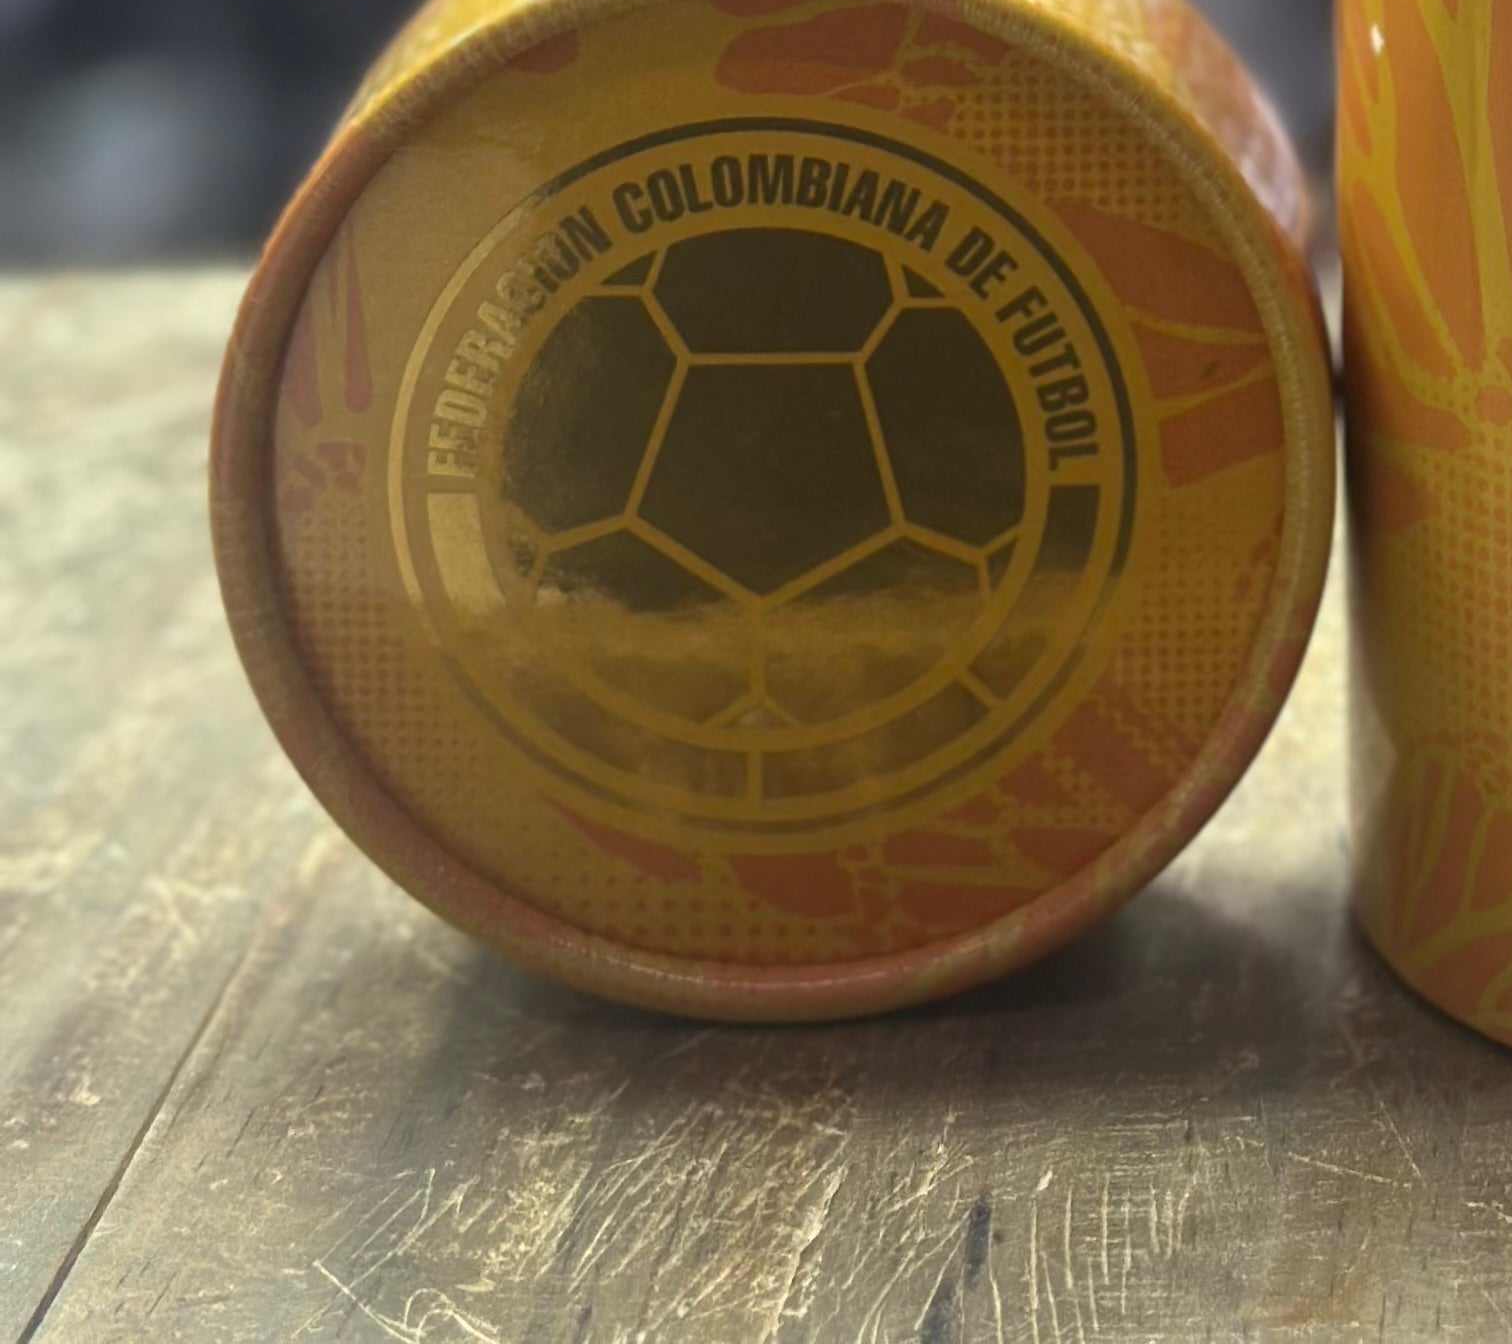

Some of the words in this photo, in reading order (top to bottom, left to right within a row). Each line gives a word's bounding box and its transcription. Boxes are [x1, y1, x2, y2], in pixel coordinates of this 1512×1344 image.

[427, 205, 613, 479] FEDERACION
[612, 153, 950, 253] COLOMBIANA
[944, 225, 1018, 301] DE
[995, 288, 1102, 472] FUTBOL
